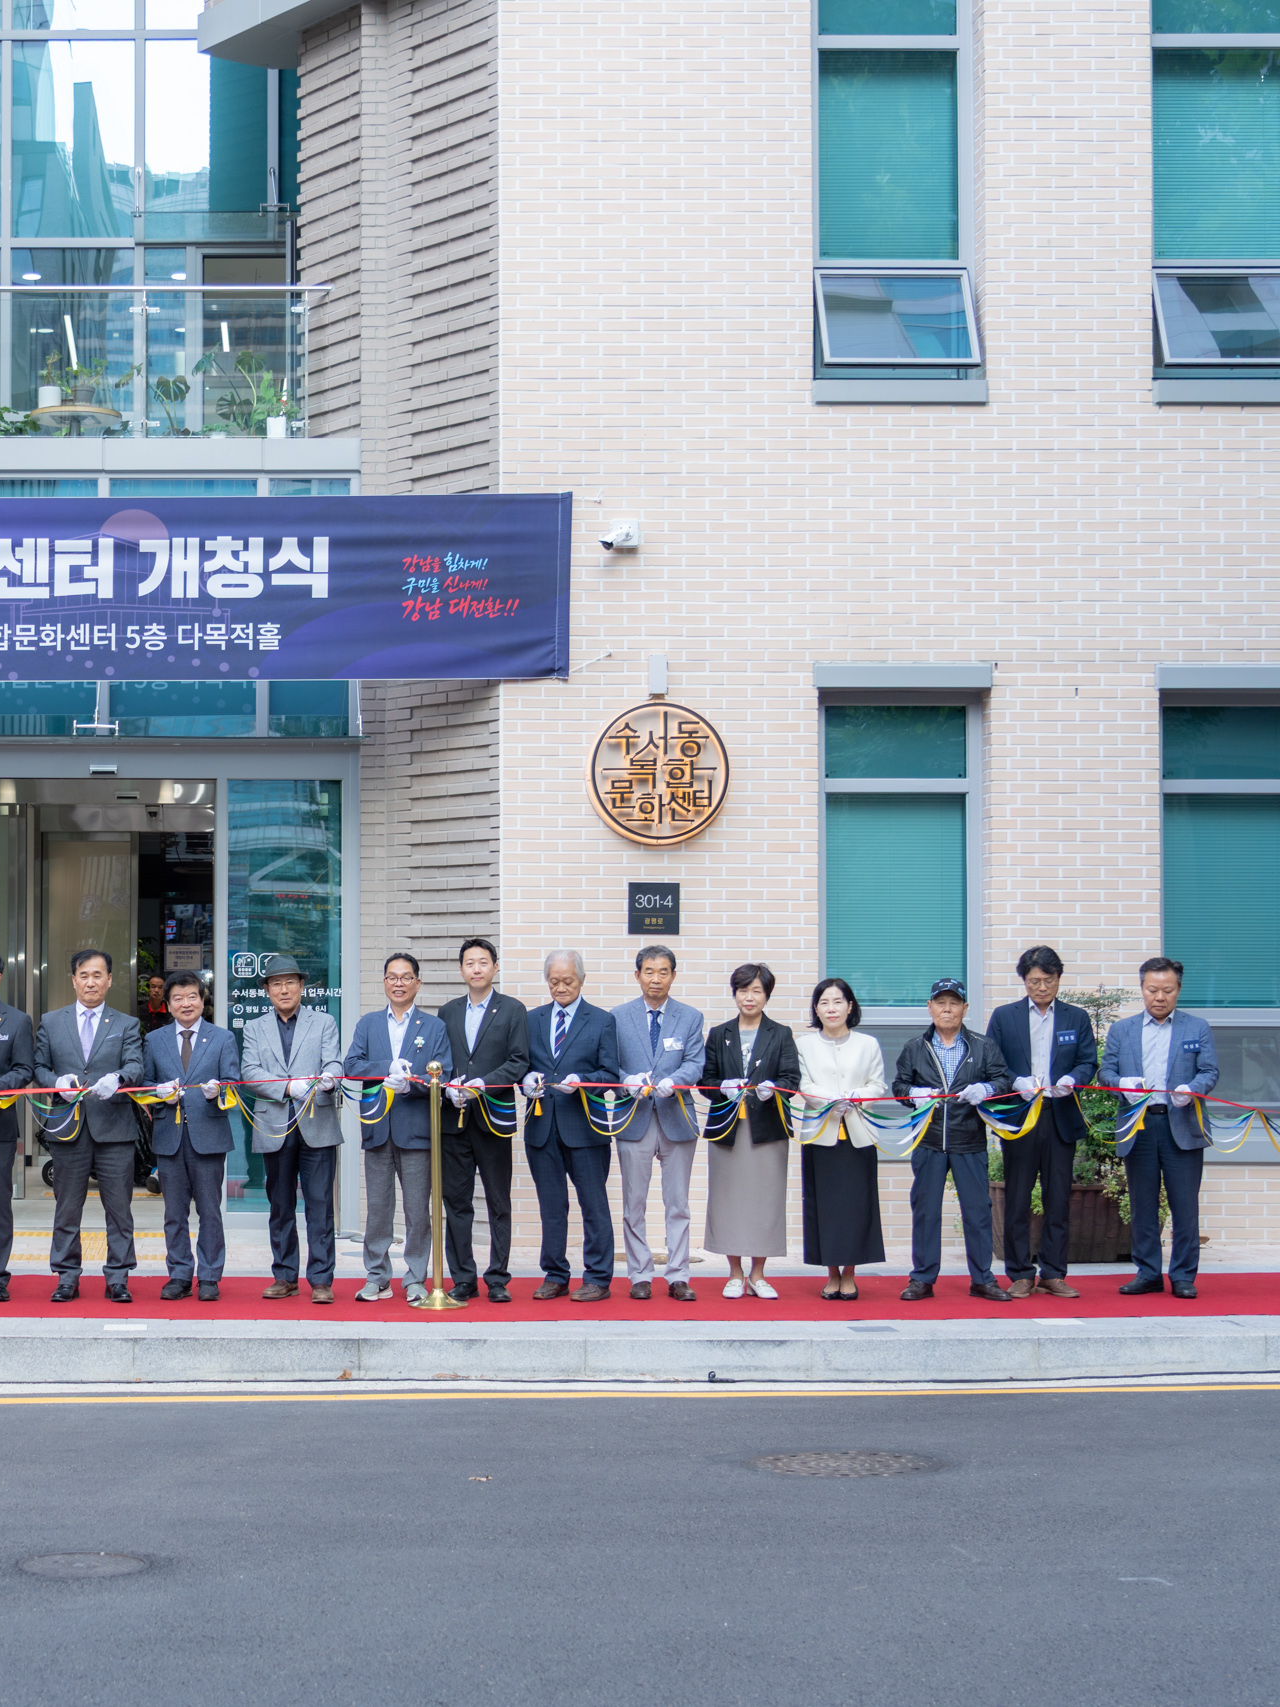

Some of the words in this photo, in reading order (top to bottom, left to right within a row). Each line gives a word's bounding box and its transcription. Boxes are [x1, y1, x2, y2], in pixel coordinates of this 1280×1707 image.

[137, 535, 330, 600] 개청식
[402, 554, 442, 573] 강남을
[443, 551, 488, 573] 힘차게!
[401, 577, 440, 596] 구민을
[442, 575, 488, 593] 신나게!
[401, 595, 444, 621] 강남
[448, 594, 520, 619] 대전환!!
[125, 622, 168, 651] 5층
[177, 622, 282, 651] 다목적홀
[605, 711, 710, 758] 수서동
[602, 757, 718, 789] 복합
[604, 779, 713, 825] 문화센터
[635, 894, 673, 908] 301-4
[308, 988, 342, 998] 업무시간
